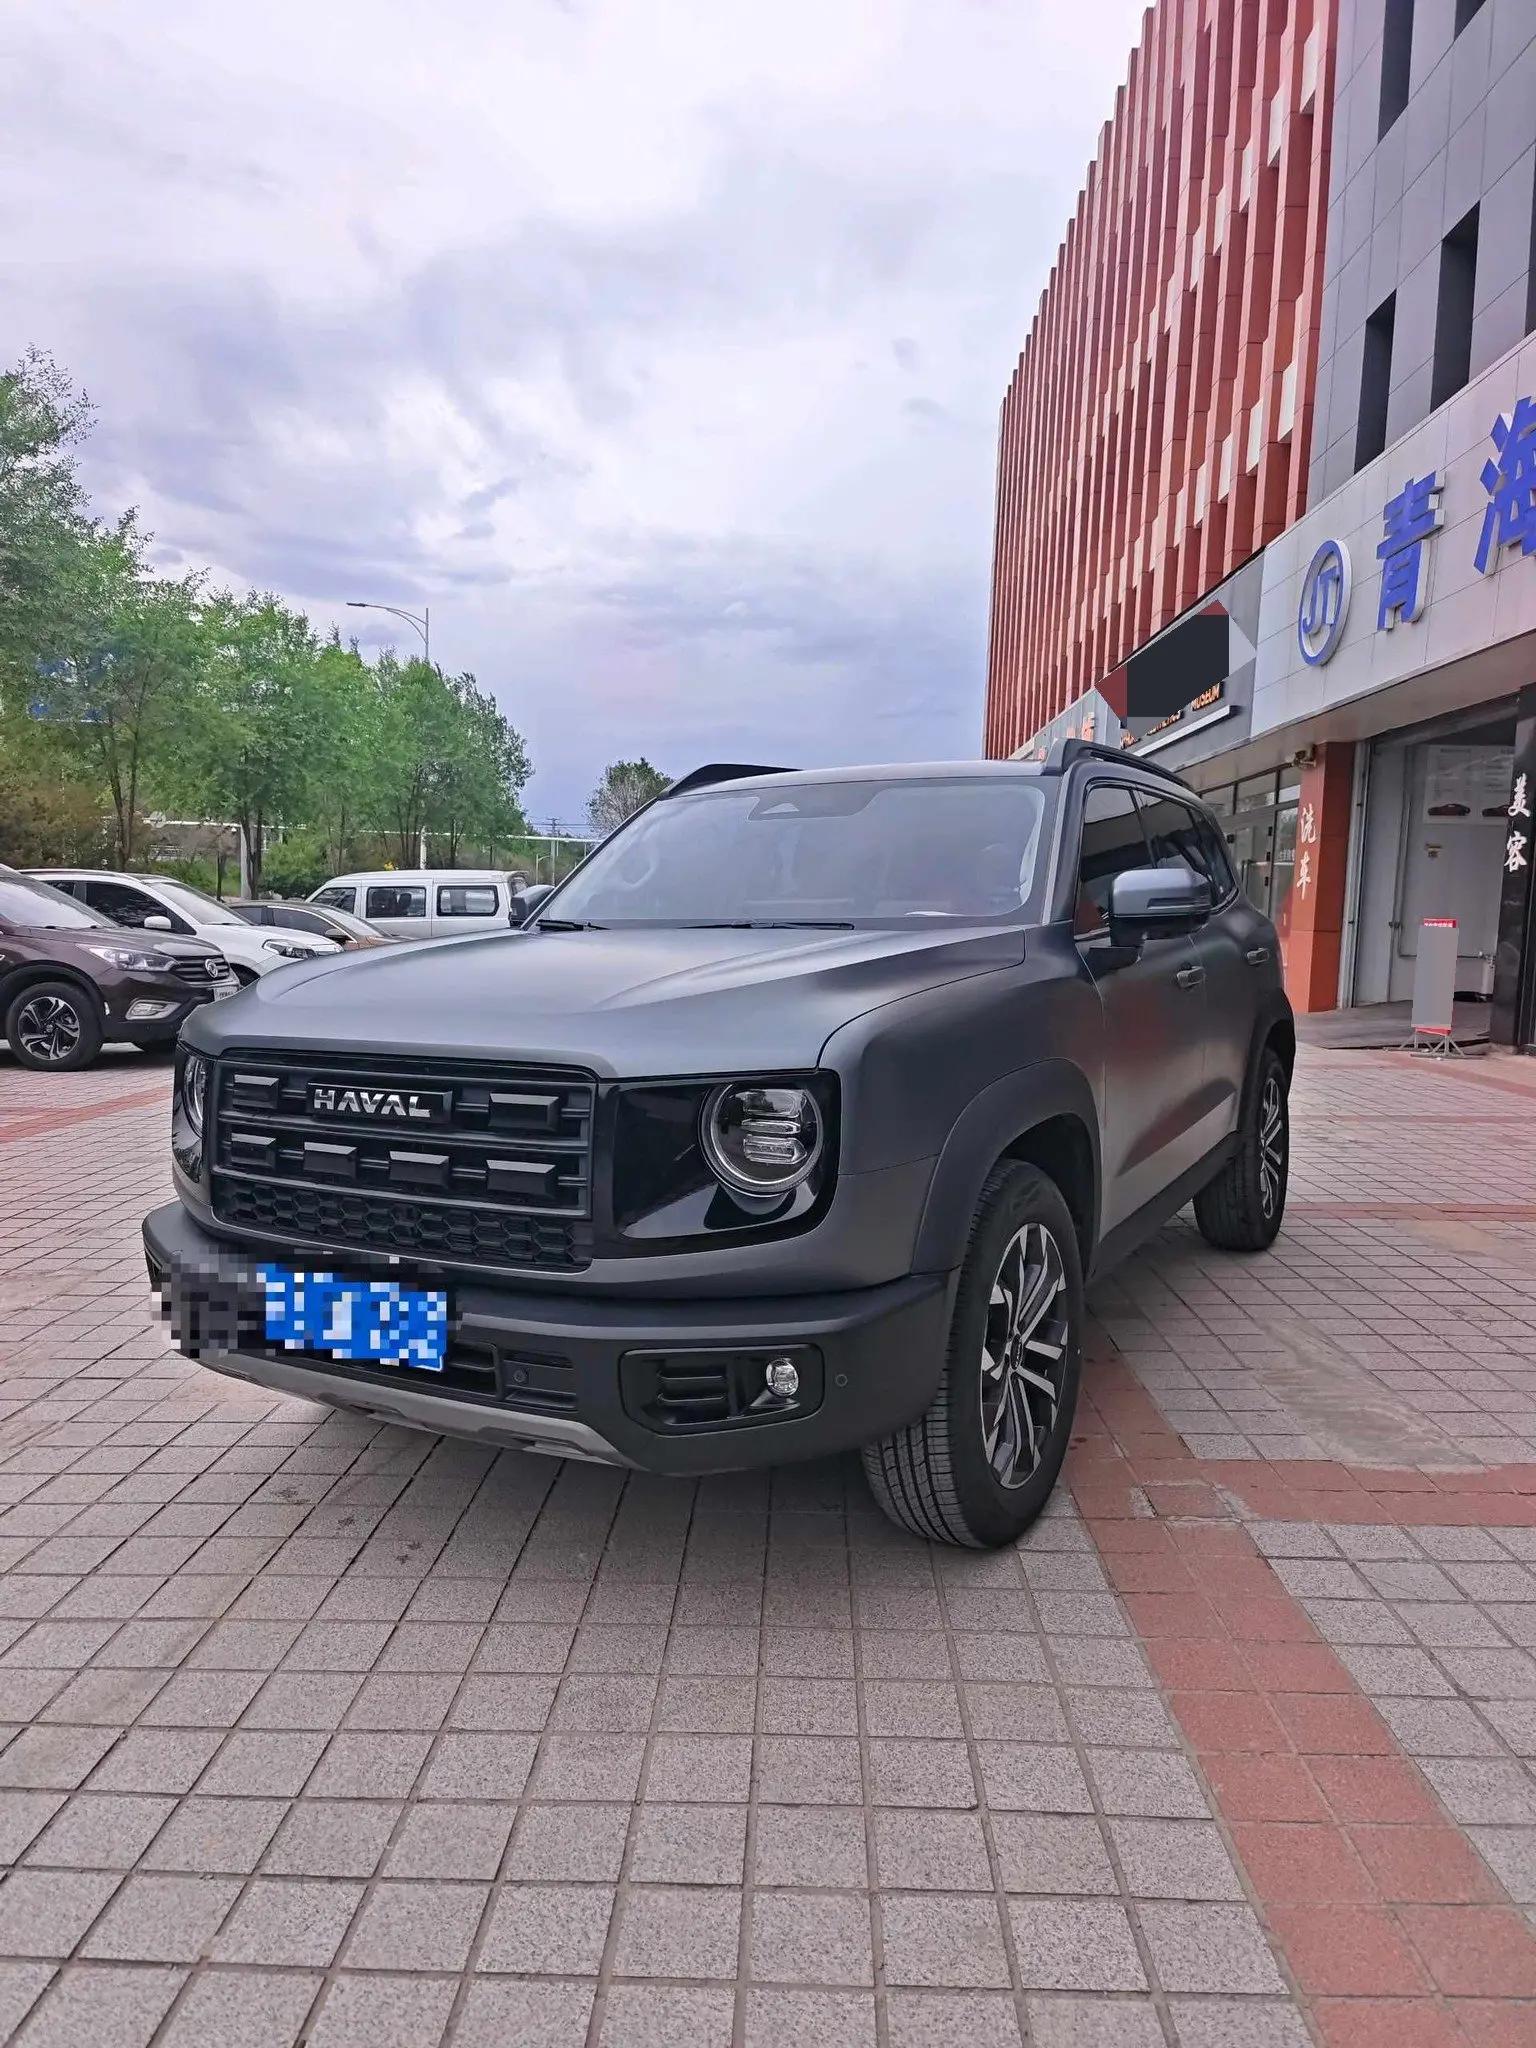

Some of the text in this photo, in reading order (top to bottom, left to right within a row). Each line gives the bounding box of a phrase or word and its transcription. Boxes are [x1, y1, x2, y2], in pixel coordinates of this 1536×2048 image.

[1296, 803, 1317, 900] 洗车
[1504, 772, 1531, 872] 美容
[314, 1088, 430, 1118] HAVAL
